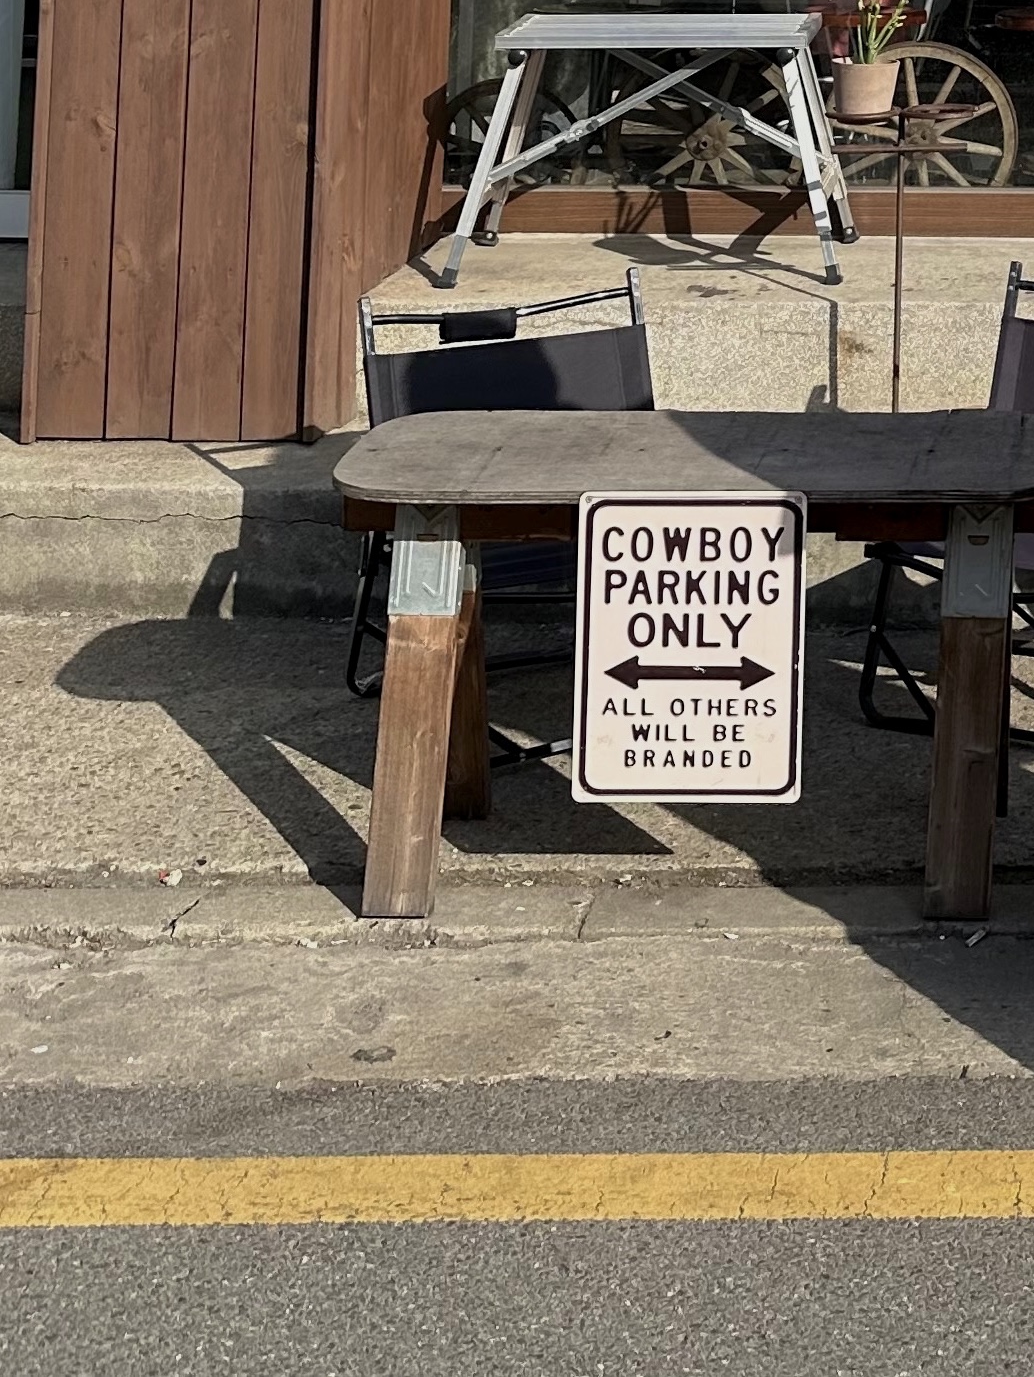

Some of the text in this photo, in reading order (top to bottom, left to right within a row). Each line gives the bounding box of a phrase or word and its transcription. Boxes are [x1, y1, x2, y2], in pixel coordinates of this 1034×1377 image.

[601, 526, 785, 563] COWBOY
[604, 569, 781, 606] PARKING
[627, 612, 753, 649] ONLY
[602, 698, 777, 717] ALL OTHERS
[631, 723, 746, 742] WILL BE
[624, 749, 752, 768] BRANDED
